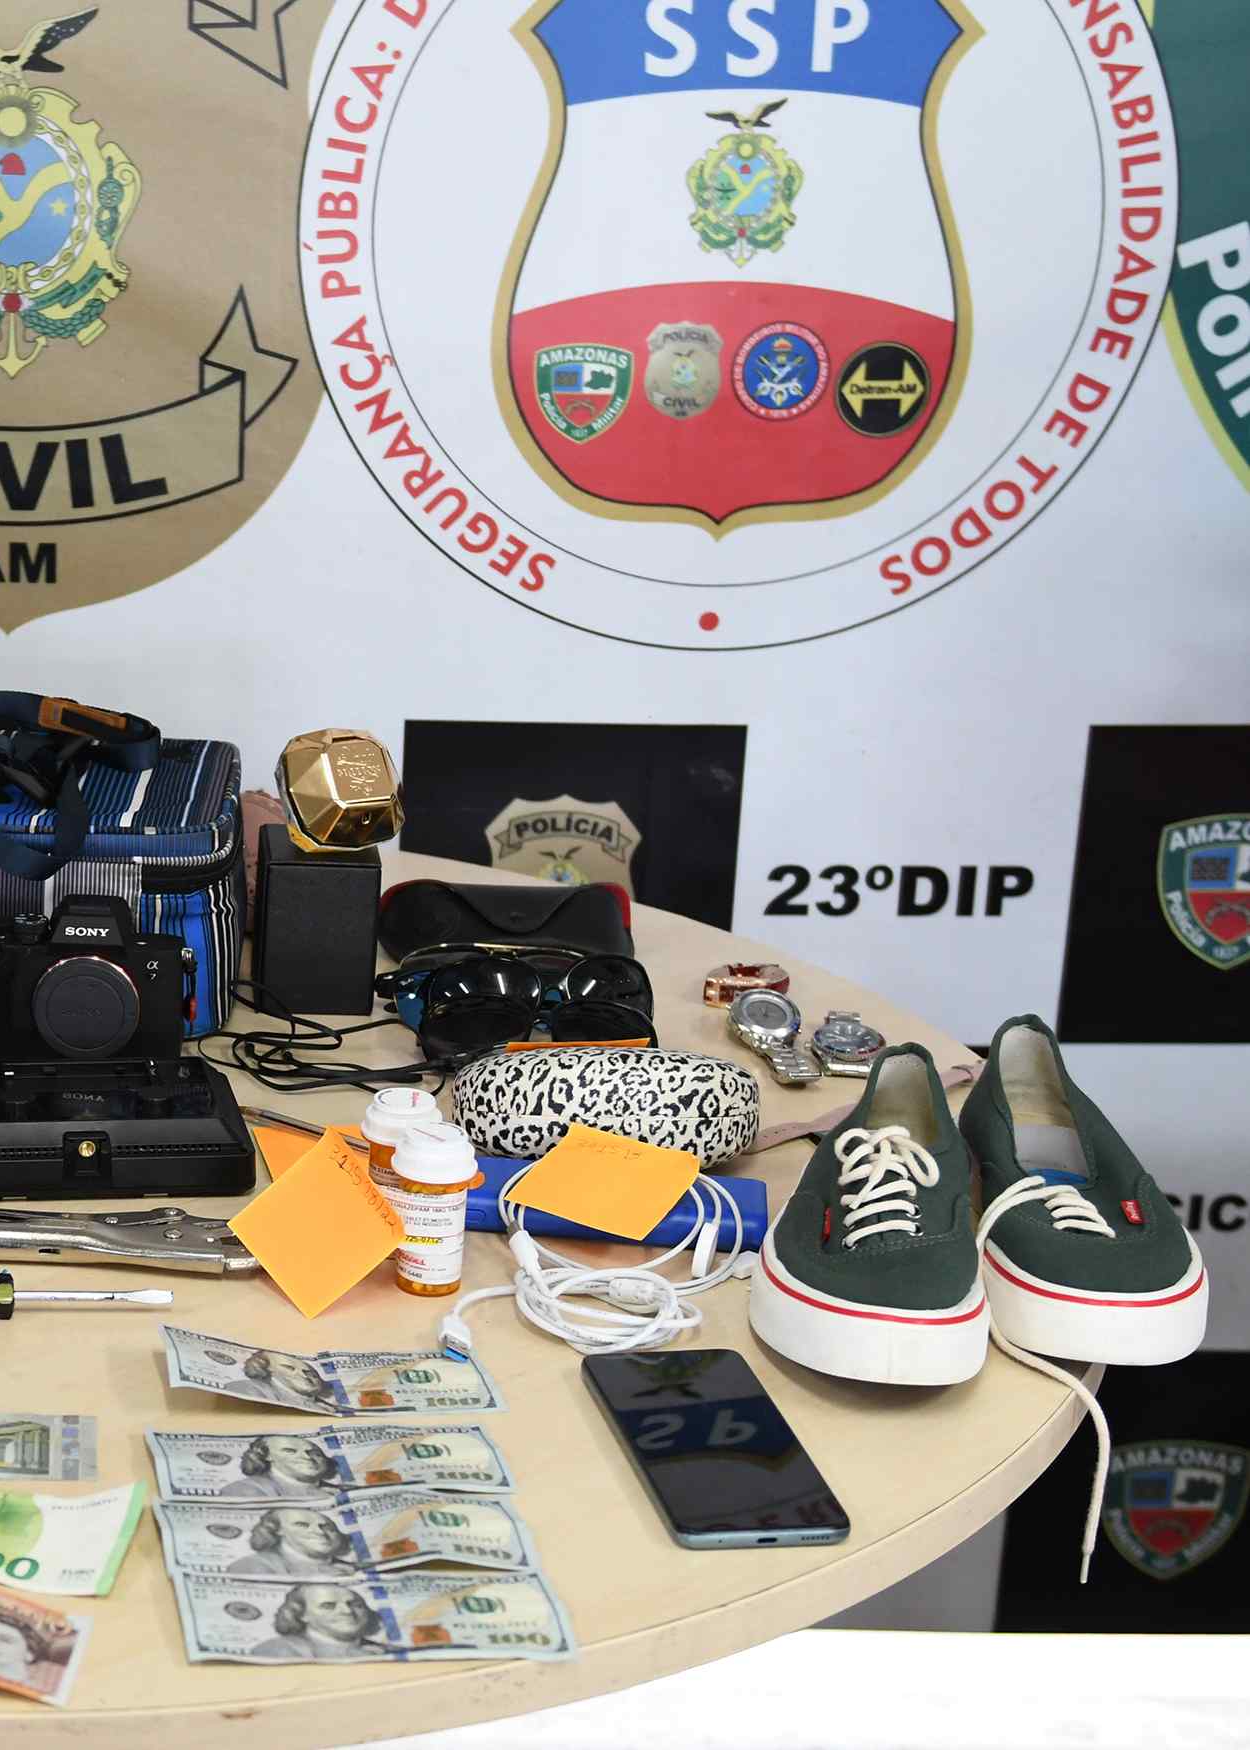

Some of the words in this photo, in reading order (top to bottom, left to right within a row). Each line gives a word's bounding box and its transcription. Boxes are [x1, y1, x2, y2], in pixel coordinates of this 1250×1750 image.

[302, 41, 403, 298] PÚBLICA:
[539, 347, 629, 368] AMAZONAS
[850, 383, 917, 395] Detran-AM
[1043, 373, 1111, 448] DE
[331, 314, 556, 592] SEGURANÇA
[879, 455, 1059, 595] TODOS
[515, 812, 614, 843] POLÍCIA
[65, 926, 110, 937] SONY
[1166, 1193, 1247, 1232] IC
